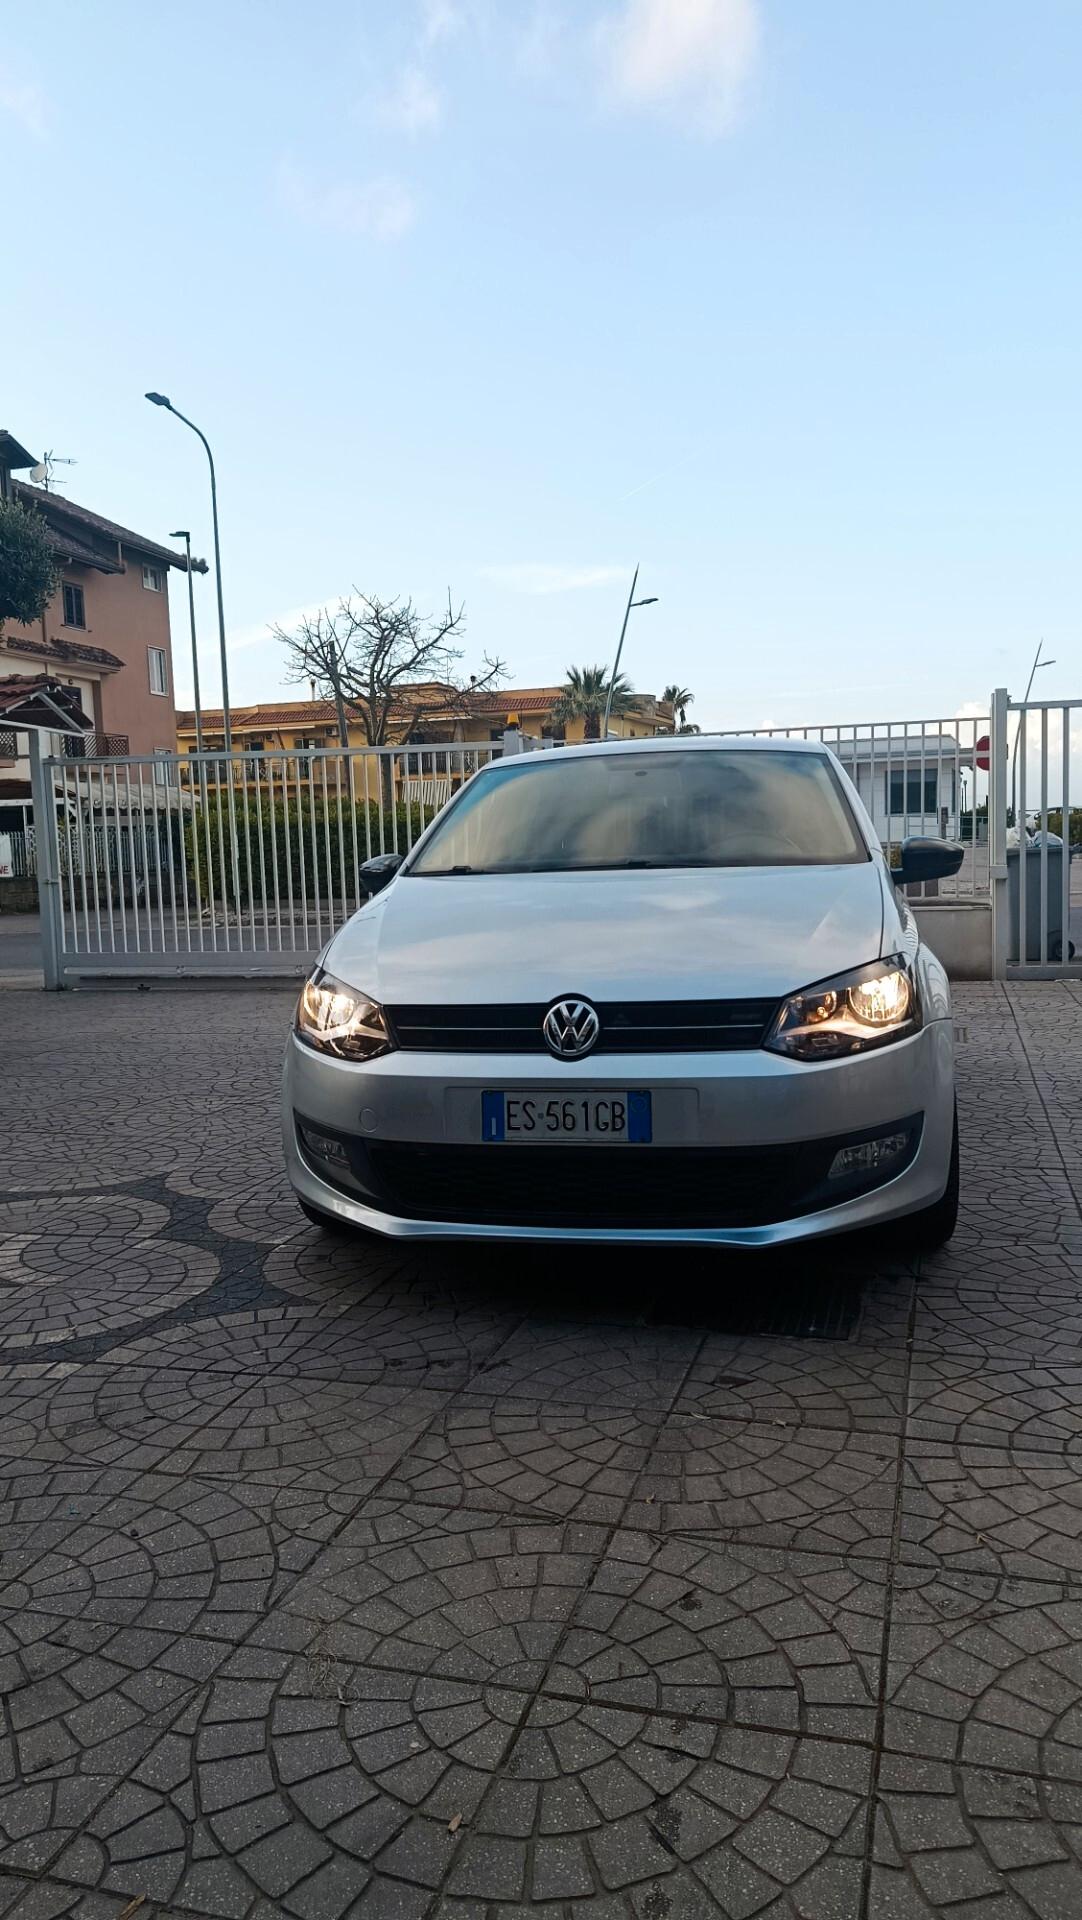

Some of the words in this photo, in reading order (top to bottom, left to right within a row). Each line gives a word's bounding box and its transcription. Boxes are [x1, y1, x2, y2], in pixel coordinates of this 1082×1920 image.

[543, 1000, 599, 1056] VW
[507, 1100, 536, 1131] ES
[546, 1100, 626, 1132] 561GB
